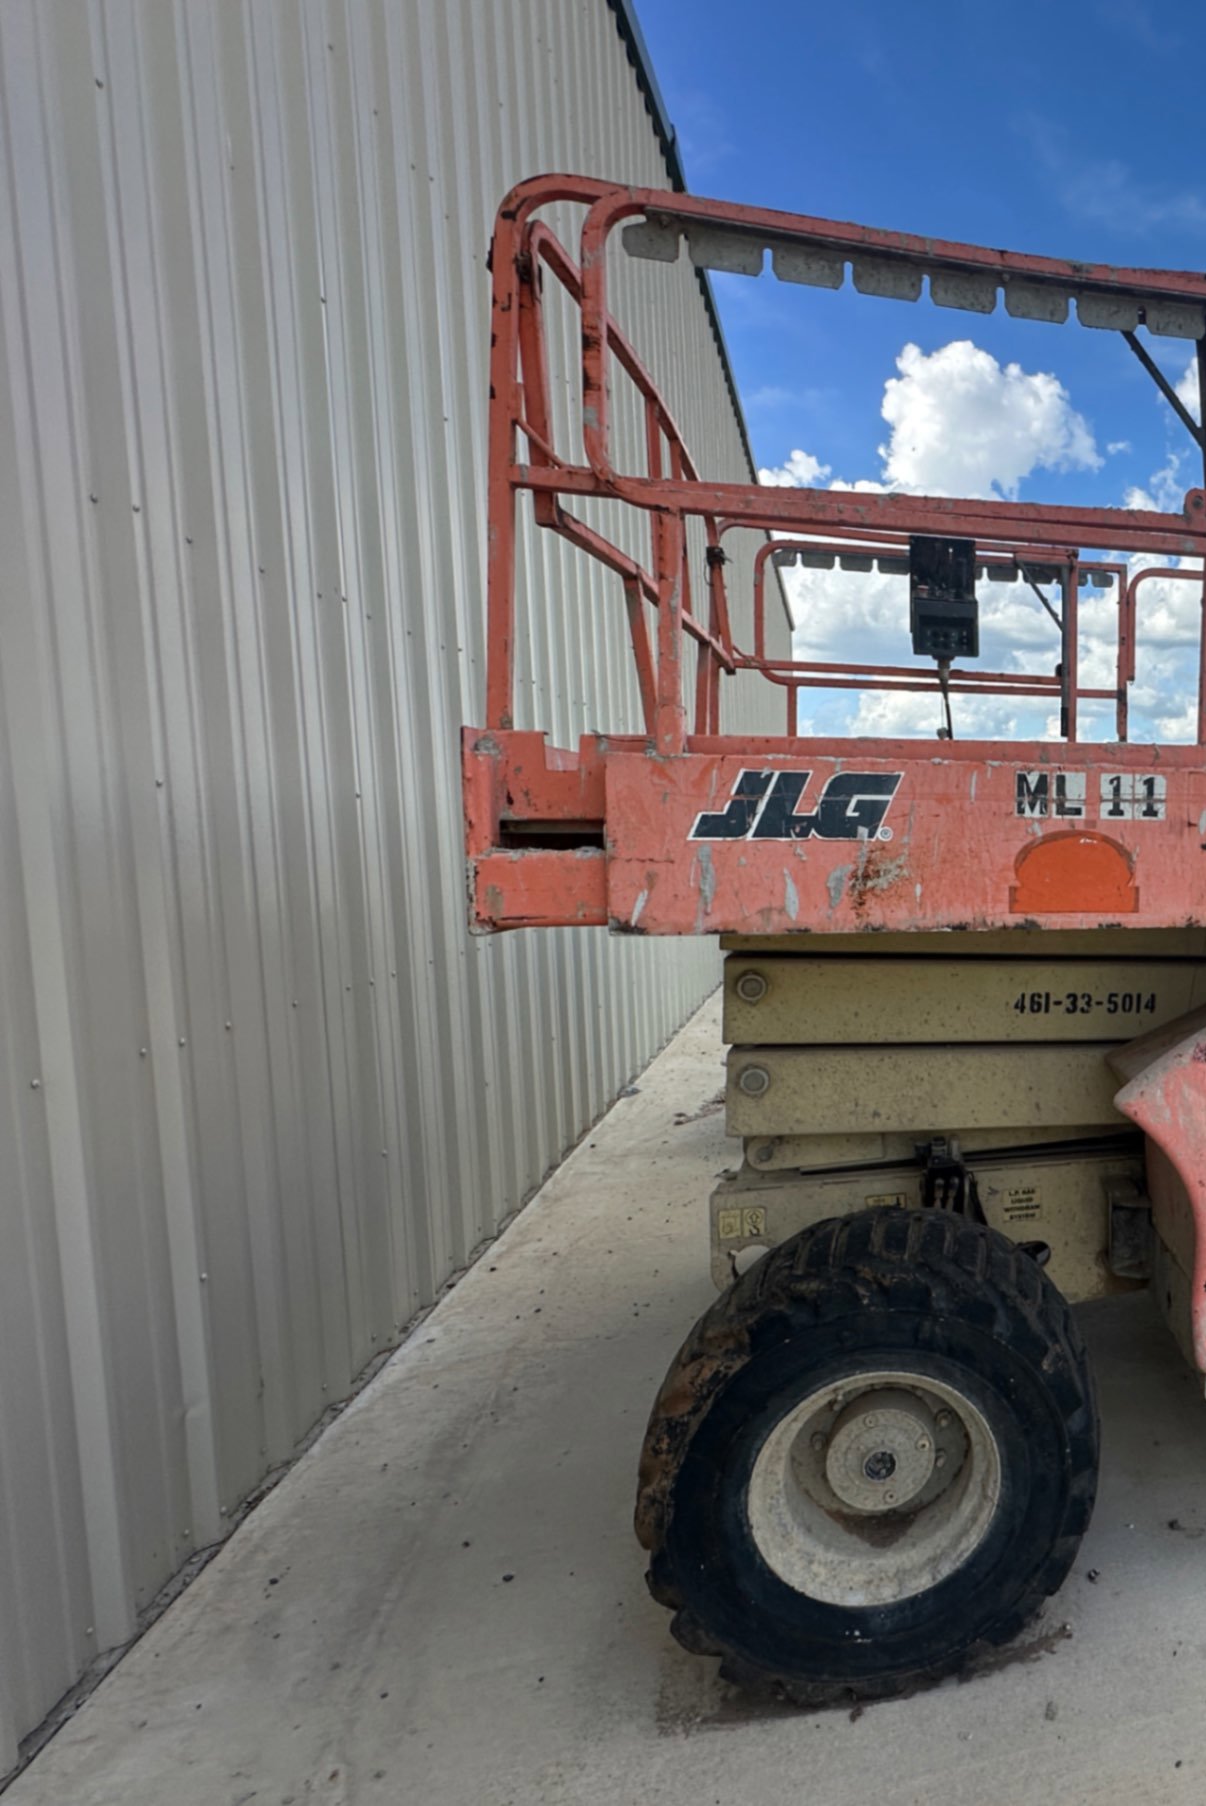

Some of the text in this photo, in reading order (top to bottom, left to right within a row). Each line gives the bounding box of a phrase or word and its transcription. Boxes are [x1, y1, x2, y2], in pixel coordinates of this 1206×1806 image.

[687, 768, 905, 841] JLG
[1016, 772, 1160, 818] ML 11
[1013, 992, 1157, 1015] 461-33-5014
